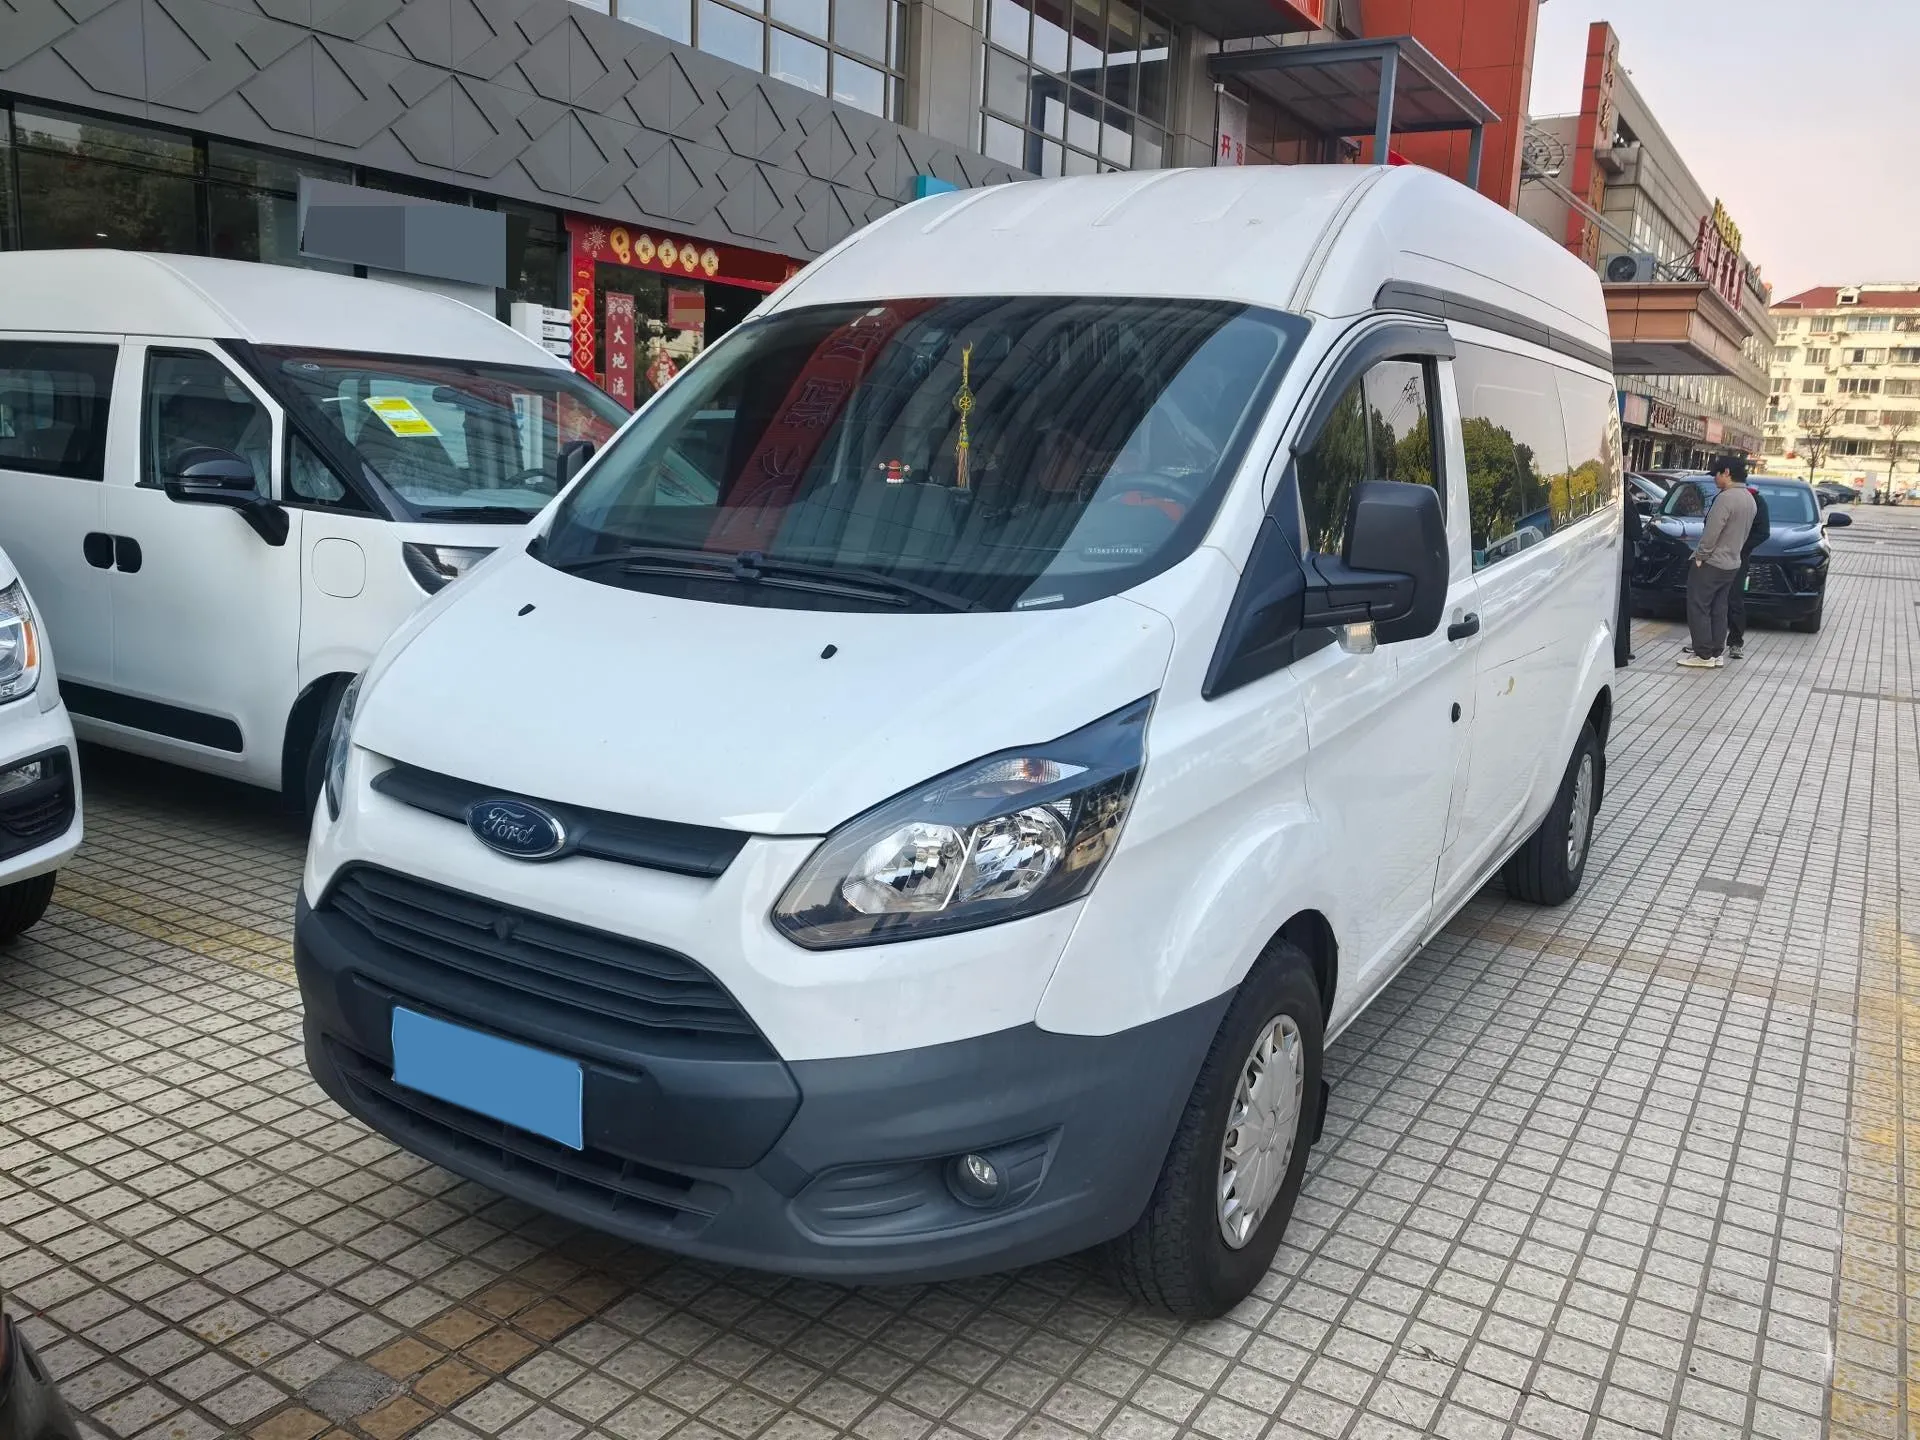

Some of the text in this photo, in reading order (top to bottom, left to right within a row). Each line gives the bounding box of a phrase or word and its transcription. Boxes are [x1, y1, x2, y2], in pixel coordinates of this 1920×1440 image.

[612, 324, 628, 397] 大地流
[482, 806, 537, 846] Ford
